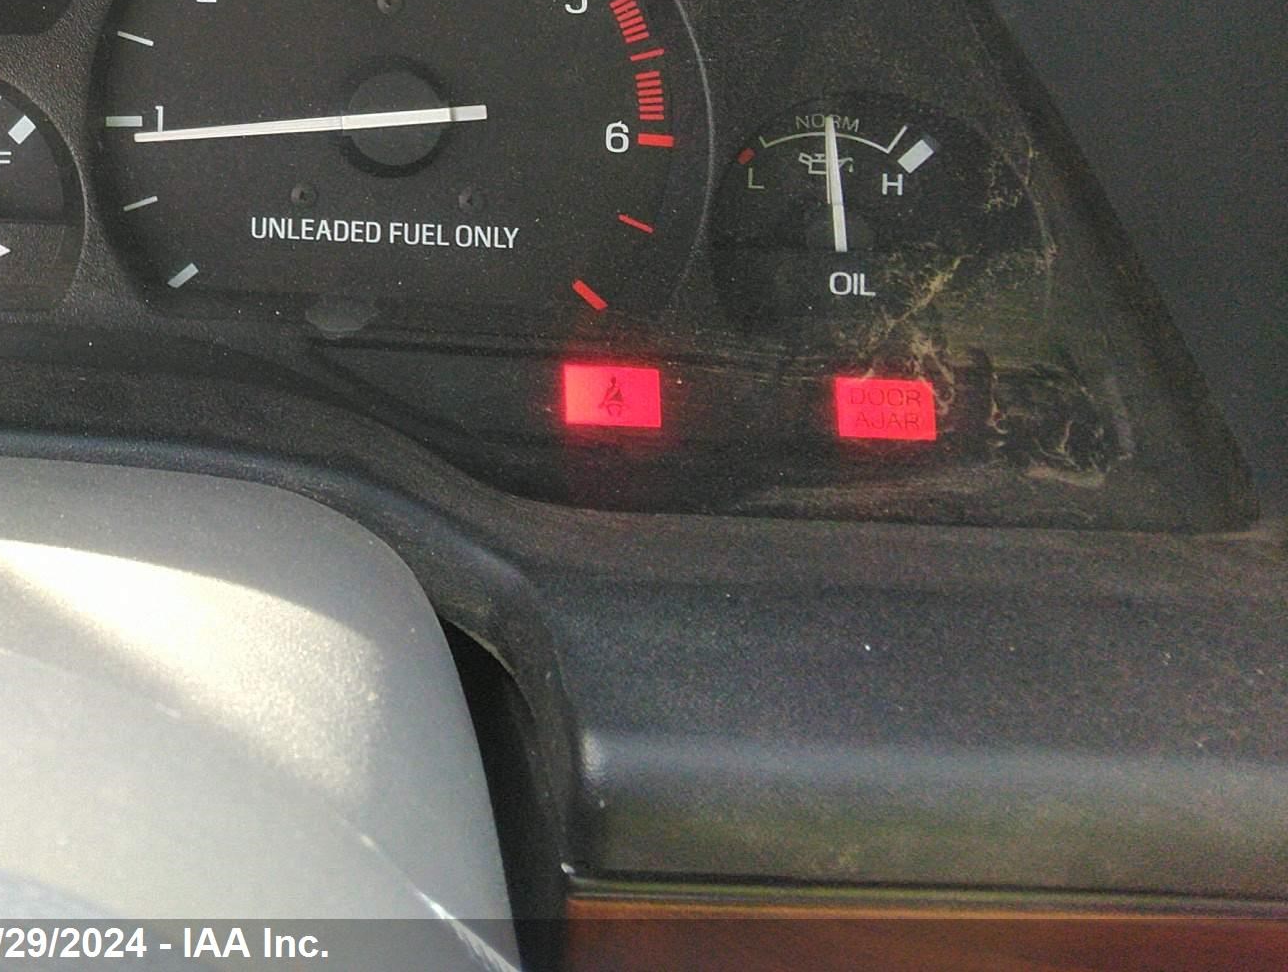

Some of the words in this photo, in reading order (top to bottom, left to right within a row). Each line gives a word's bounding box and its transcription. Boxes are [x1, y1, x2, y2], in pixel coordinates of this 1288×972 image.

[155, 106, 164, 132] 1
[795, 114, 859, 133] NORM
[605, 121, 629, 153] 6
[749, 168, 764, 189] L
[882, 173, 903, 196] H
[251, 217, 381, 244] UNLEADED
[389, 222, 449, 246] FUEL
[455, 224, 519, 249] ONLY
[829, 272, 876, 296] OIL
[850, 387, 921, 407] DOOR
[856, 412, 920, 430] AJAR
